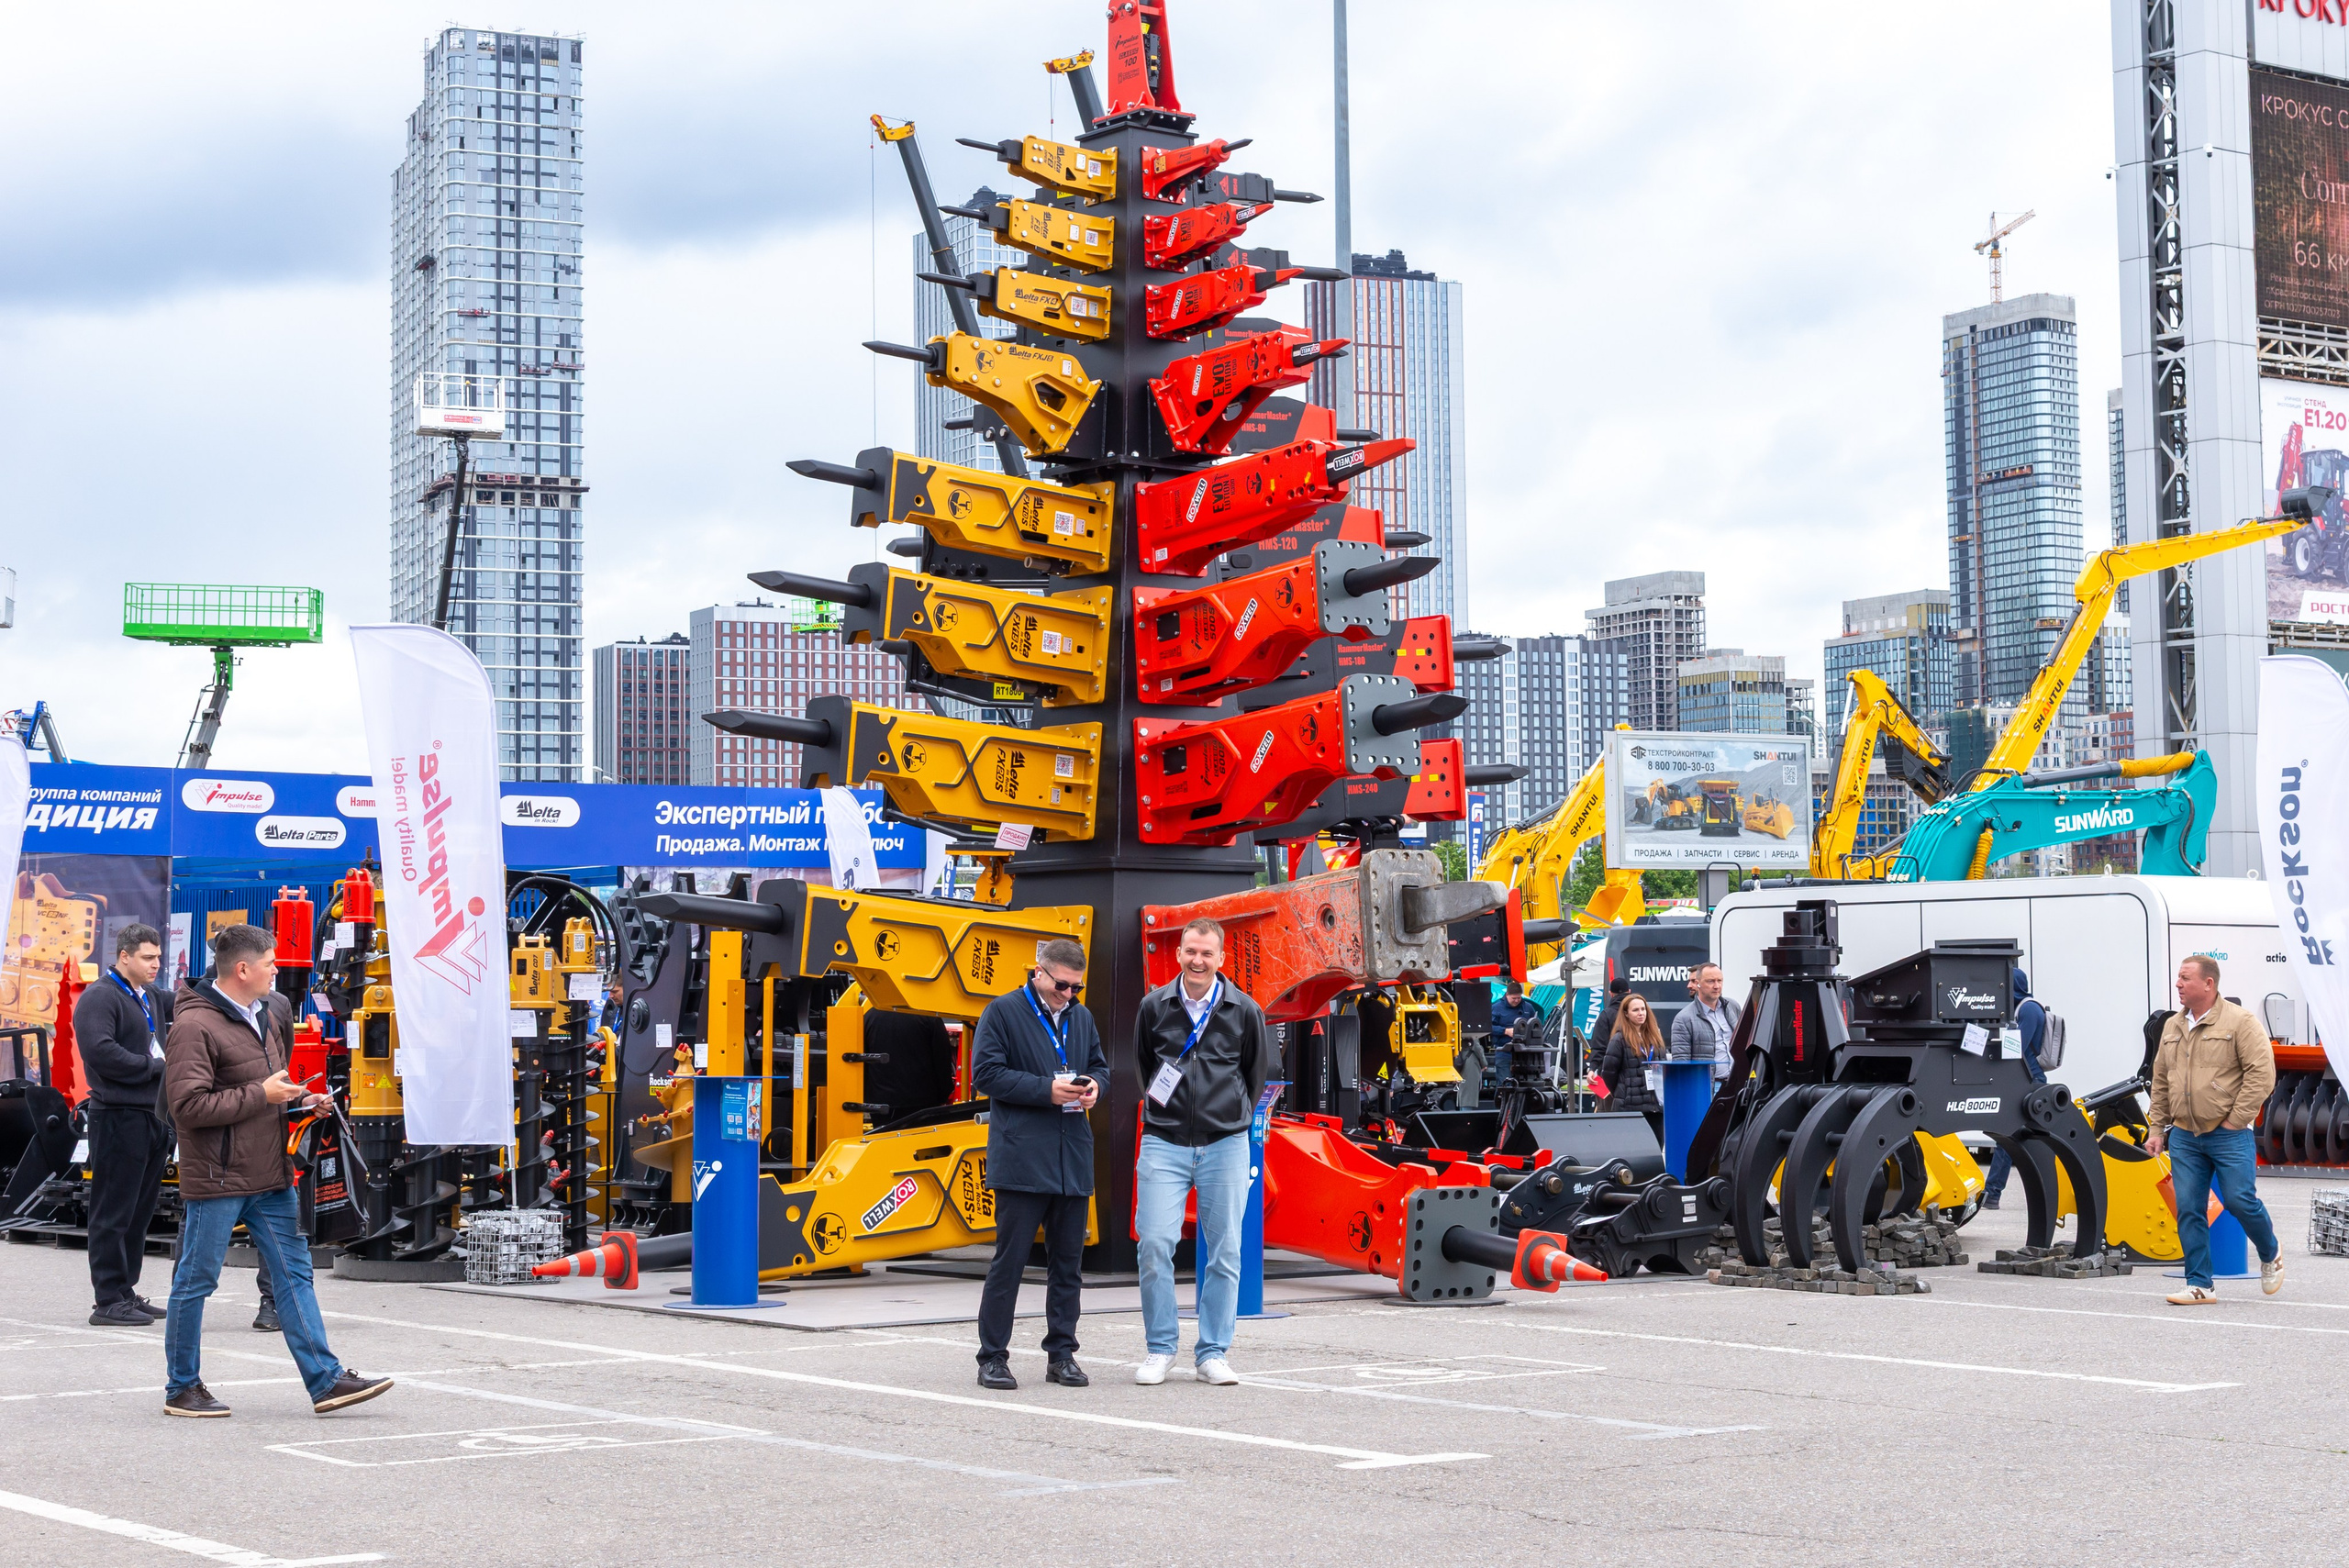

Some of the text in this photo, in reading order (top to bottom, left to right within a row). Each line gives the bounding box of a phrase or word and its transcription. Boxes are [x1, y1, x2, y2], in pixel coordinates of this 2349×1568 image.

[1124, 56, 1138, 67] 100
[2262, 94, 2332, 126] КРОКУС
[2295, 241, 2321, 268] 66
[1185, 291, 1194, 316] EVO
[1212, 363, 1225, 397] EVO
[2304, 398, 2326, 408] СТЕНД
[2304, 408, 2349, 431] E1.20
[1333, 450, 1364, 470] ROXWELL
[1187, 479, 1207, 522] ROXWELL
[1211, 483, 1224, 514] EVO
[1032, 496, 1044, 532] Delta
[1258, 537, 1297, 550] HMS-120
[1235, 599, 1257, 639] ROXWELL
[2310, 602, 2349, 614] РОСТ
[1024, 616, 1038, 659] Delta
[2033, 679, 2065, 732] SHANTUI
[1251, 731, 1274, 773] ROXWELL
[1648, 749, 1714, 760] ТЕХСТРОЙКОНТРАКТ
[1753, 751, 1797, 762] SHANTUI
[995, 747, 1006, 793] FX20S
[1009, 750, 1026, 800] Delta
[1648, 762, 1715, 772] 8 800 700-30-03
[1854, 739, 1872, 793] SANTUI
[29, 788, 162, 803] руппа компаний
[1347, 784, 1378, 795] HMS-240
[517, 800, 561, 818] Delta
[654, 801, 810, 829] Экспертный
[1570, 794, 1598, 838] SHANTUI
[2054, 801, 2133, 833] SUNWARD
[264, 824, 339, 841] Delta Parts
[656, 835, 745, 856] Продажа.
[749, 835, 820, 852] Монтаж
[1634, 850, 1672, 859] ПРОДАЖА
[1684, 850, 1722, 859] ЗАПЧАСТИ
[1733, 851, 1760, 859] СЕРВИС
[1771, 851, 1799, 860] АРЕНДА
[972, 937, 982, 980] FX35S
[985, 939, 1000, 985] Delta
[1252, 933, 1261, 975] R600
[1630, 966, 1689, 982] SUNWAR
[650, 1077, 674, 1086] Rockso
[863, 1177, 914, 1228] ROXWELL
